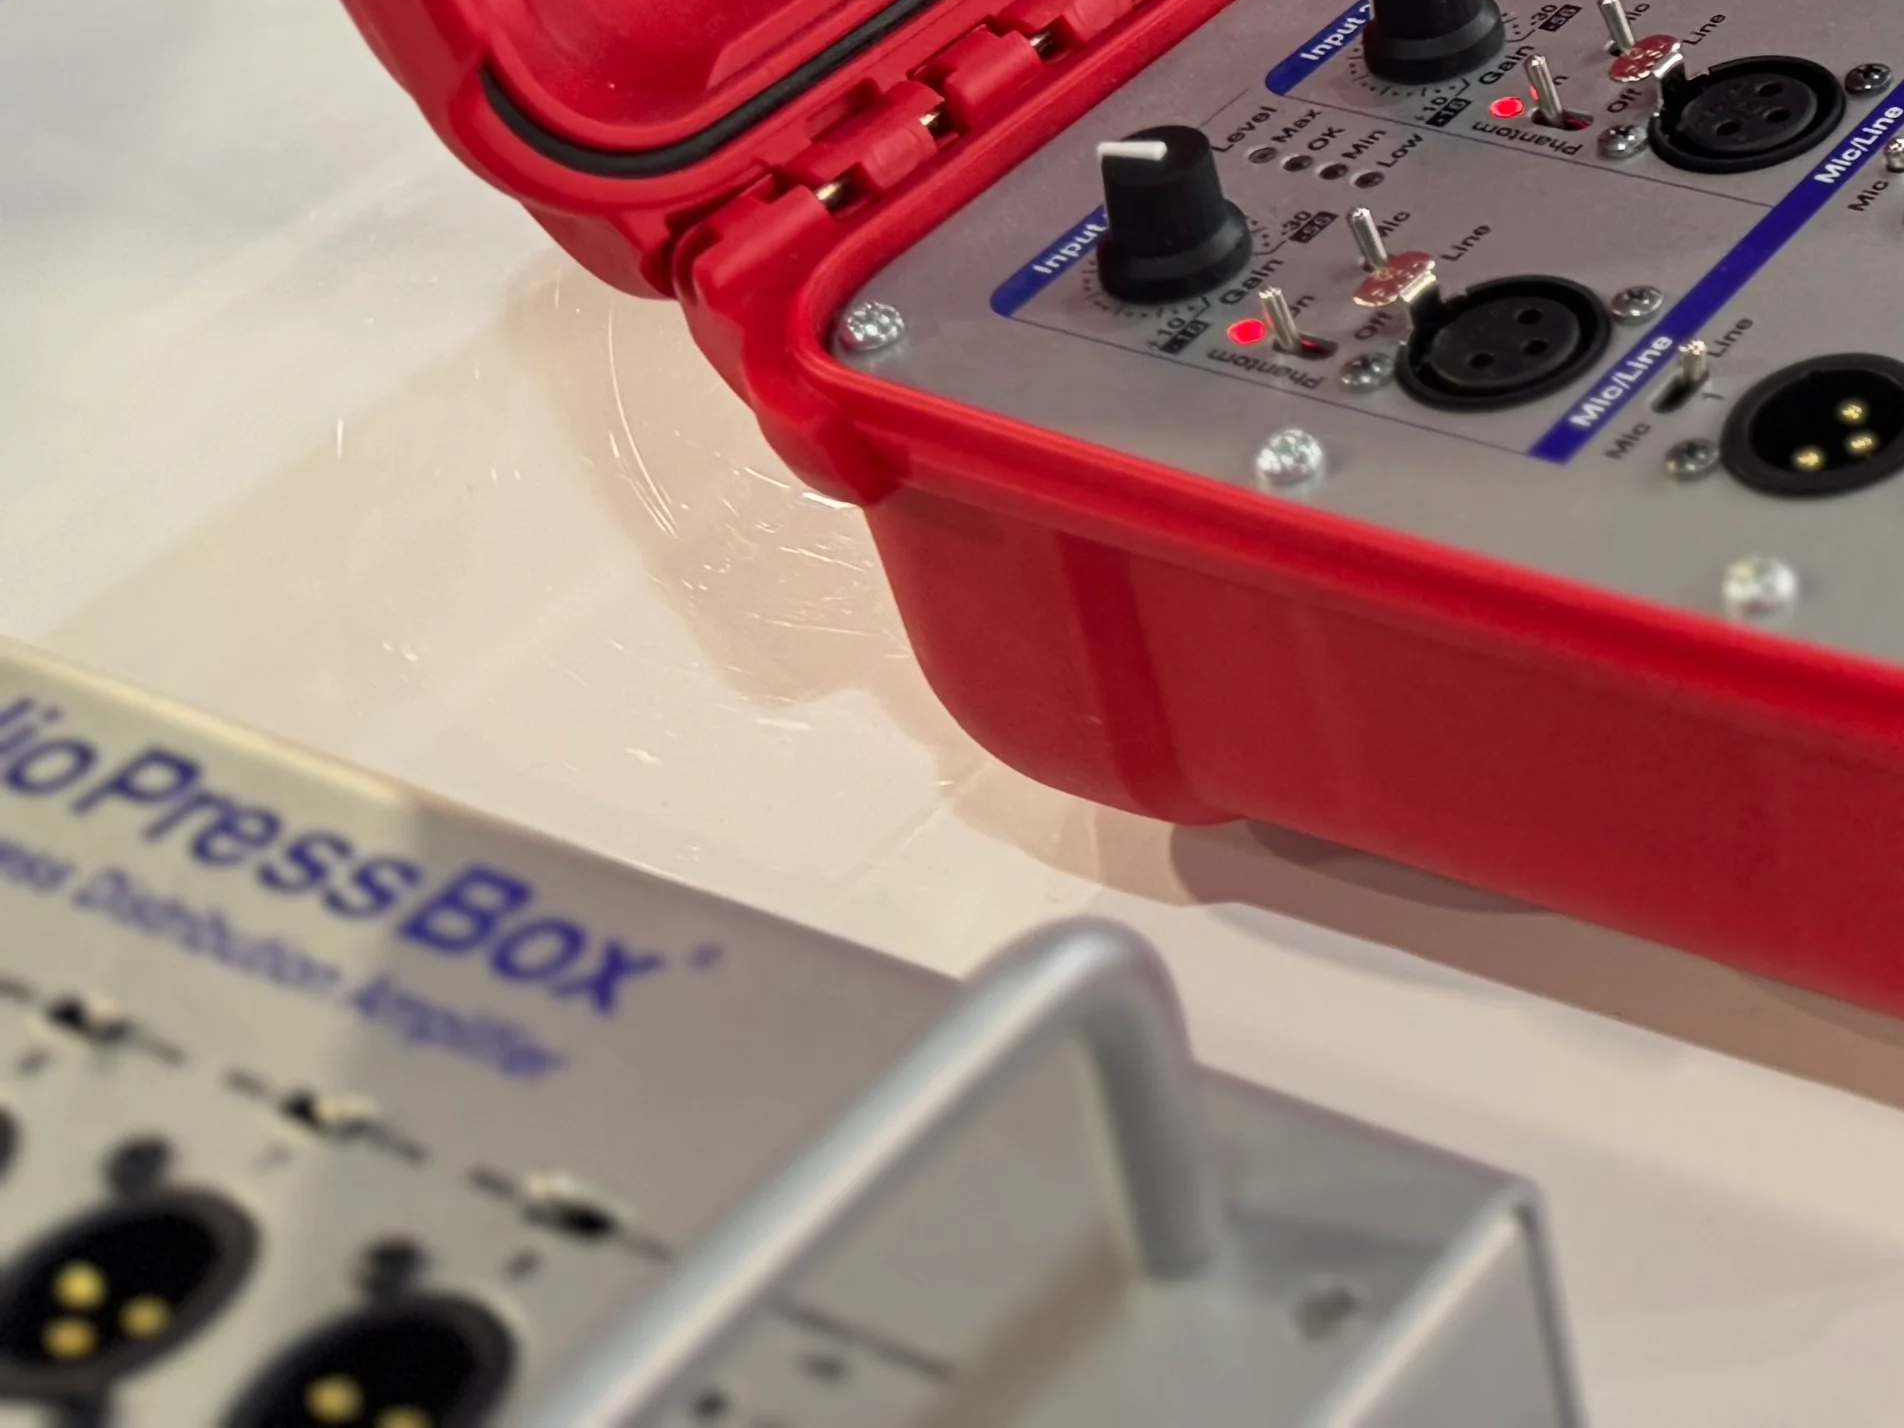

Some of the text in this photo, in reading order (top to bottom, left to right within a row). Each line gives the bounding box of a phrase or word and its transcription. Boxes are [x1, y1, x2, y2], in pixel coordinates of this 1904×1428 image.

[1301, 17, 1366, 60] Input
[1683, 13, 1726, 45] Line
[1479, 45, 1534, 86] Gain
[1607, 87, 1642, 113] Off
[1210, 106, 1278, 153] Level
[1272, 108, 1322, 143] Max
[1307, 126, 1346, 152] OK
[1341, 129, 1387, 160] Min
[1472, 120, 1583, 156] Phantom
[1814, 104, 1904, 185] Mic/Line
[1377, 133, 1424, 168] Low
[1848, 178, 1890, 212] Mic
[1032, 223, 1108, 275] Input
[1440, 224, 1492, 262] Line
[1219, 259, 1283, 306] Gain
[1354, 312, 1392, 340] Off
[1709, 317, 1756, 358] Line
[1206, 348, 1324, 390] Phantom
[1568, 335, 1673, 429] Mic/Line
[1604, 420, 1652, 462] Mic
